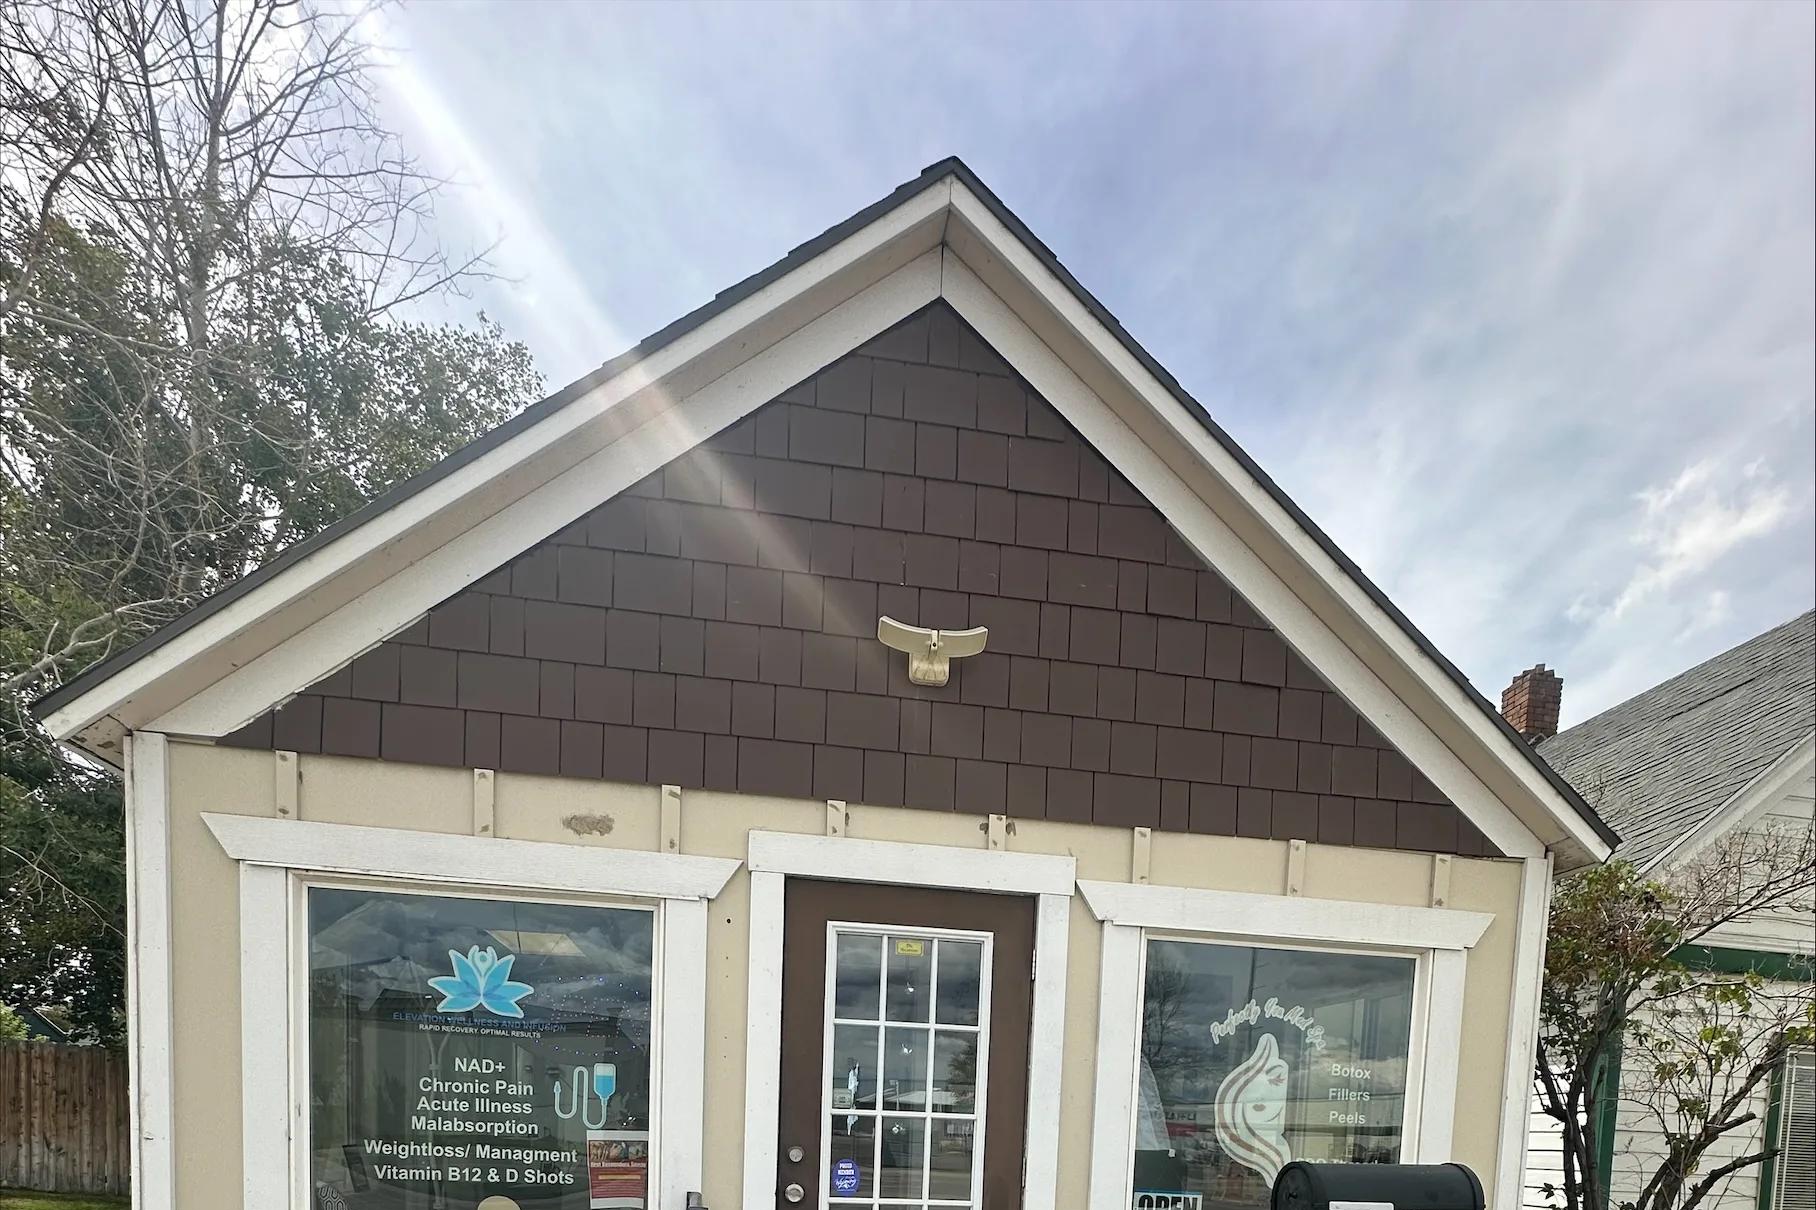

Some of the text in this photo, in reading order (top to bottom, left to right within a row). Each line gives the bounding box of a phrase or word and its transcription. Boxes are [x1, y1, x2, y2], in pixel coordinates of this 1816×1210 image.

[393, 1012, 567, 1032] ELEVATION WELLNESS AND INFUSION
[442, 1025, 478, 1034] RECOVERY
[480, 1028, 510, 1036] OPTIMAL
[511, 1030, 541, 1038] RESULTS
[454, 1057, 506, 1074] NAD+
[1331, 1063, 1372, 1080] Botox
[419, 1077, 534, 1096] Chronic Pain
[1328, 1088, 1371, 1102] Fillers
[416, 1096, 533, 1114] Acute Illness
[411, 1116, 539, 1136] Malabsorption
[1329, 1111, 1366, 1125] Peels
[364, 1139, 578, 1164] Weightloss/ Managment
[374, 1165, 574, 1185] Vitamin B12 & D Shots
